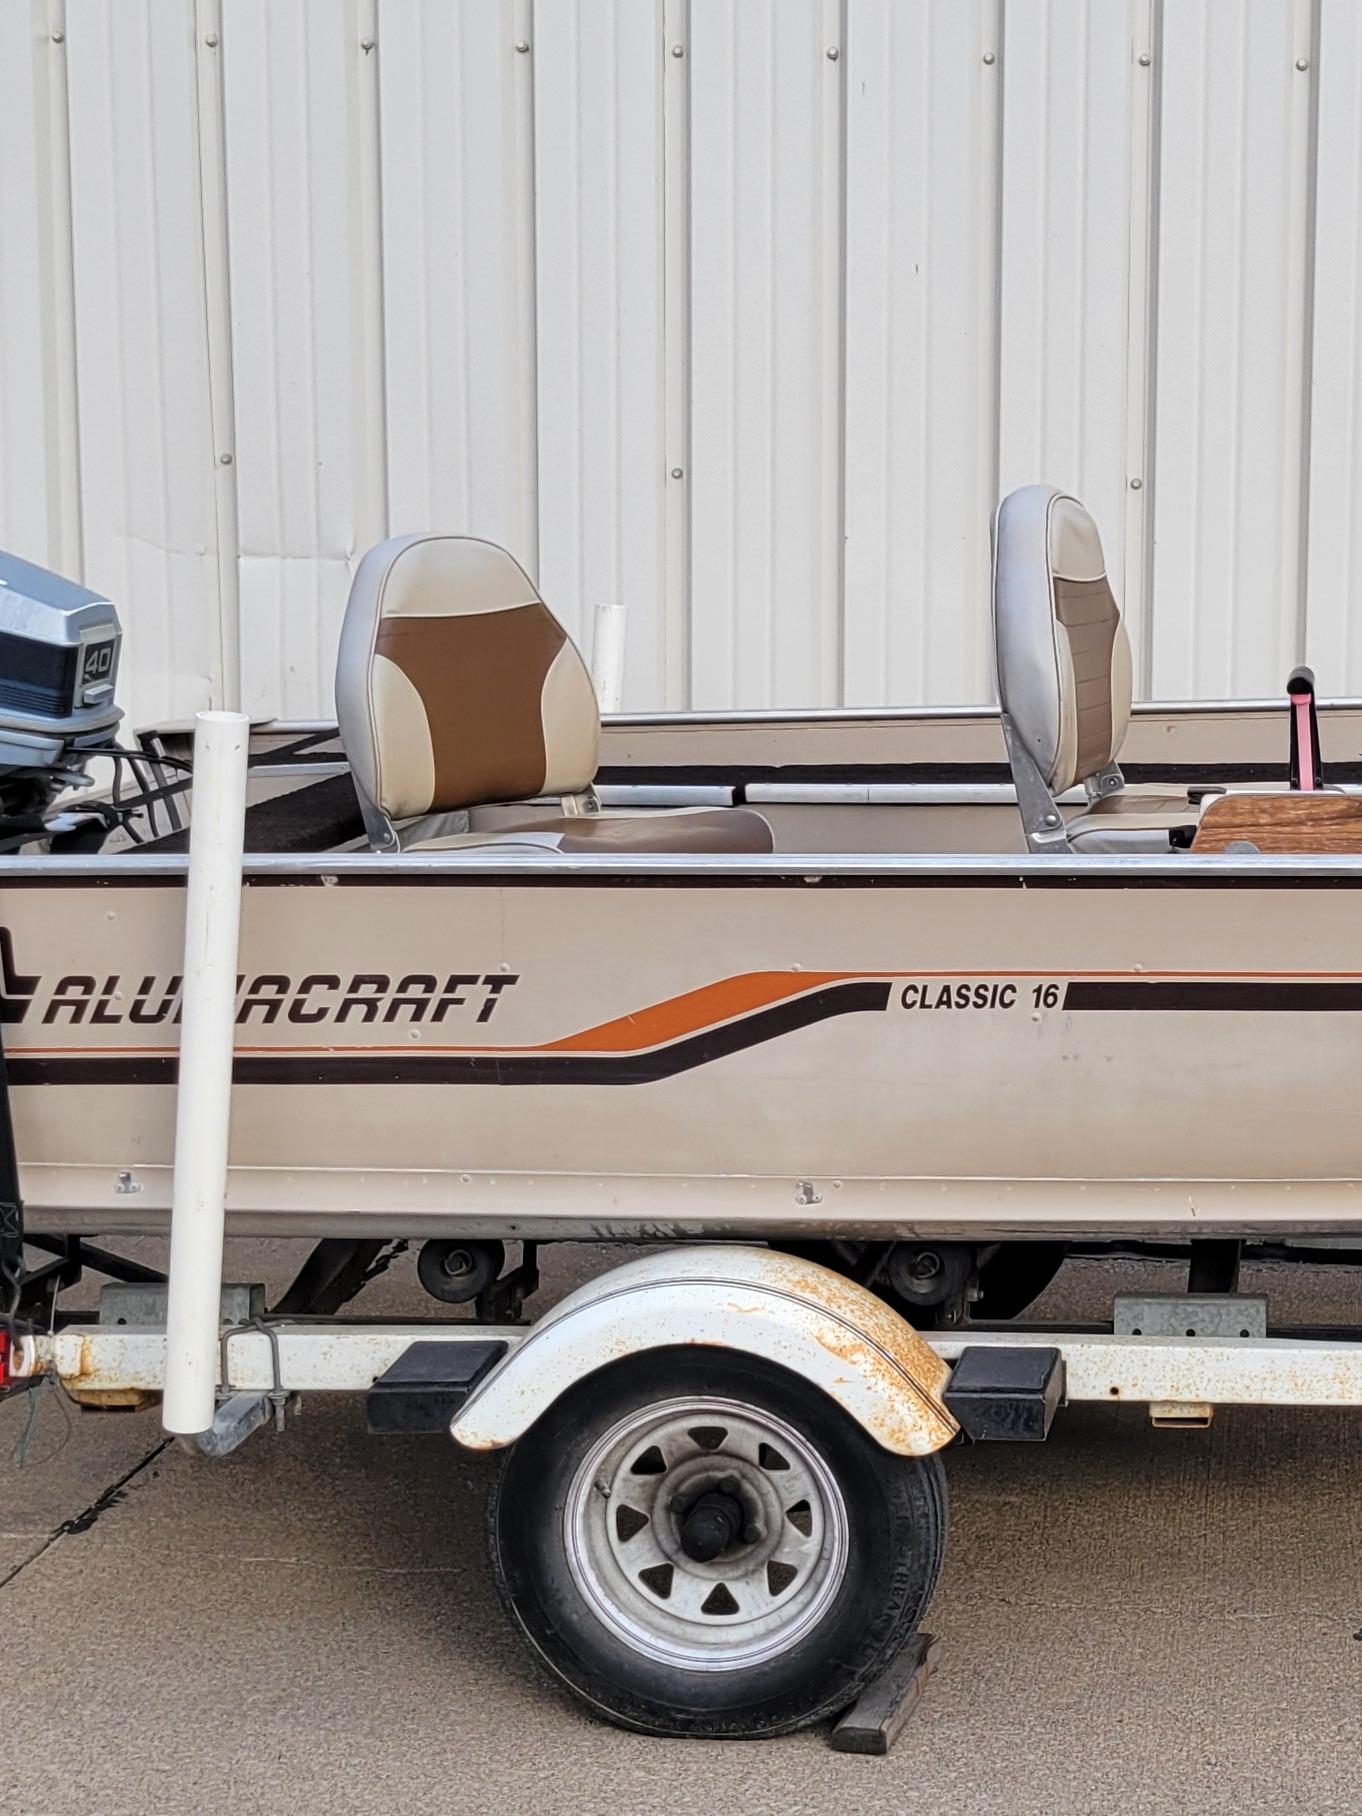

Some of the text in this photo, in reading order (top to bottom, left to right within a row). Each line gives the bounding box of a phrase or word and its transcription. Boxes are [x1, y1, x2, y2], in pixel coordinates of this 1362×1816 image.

[85, 647, 111, 674] 40
[41, 974, 520, 1024] ALUACRAFT
[901, 984, 1060, 1009] CLASSIC 16
